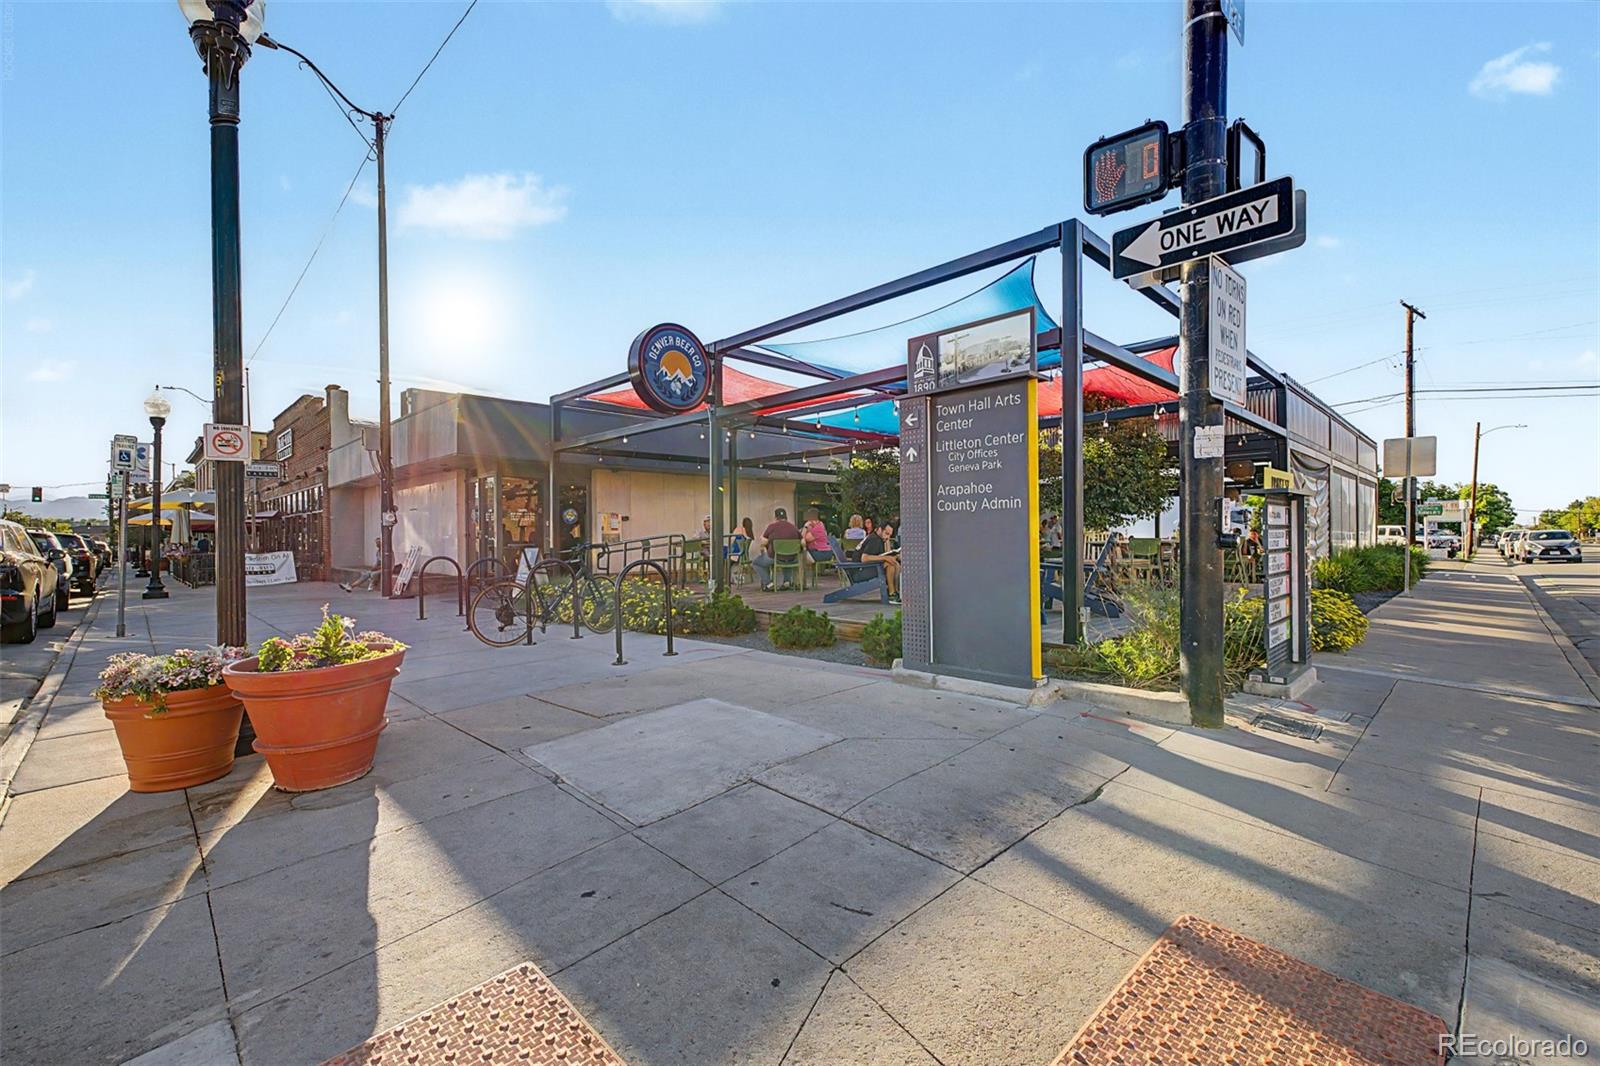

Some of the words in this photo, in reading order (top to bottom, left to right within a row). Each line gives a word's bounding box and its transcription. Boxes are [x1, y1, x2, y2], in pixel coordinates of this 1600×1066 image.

[1161, 220, 1206, 251] ONE
[1217, 200, 1270, 235] WAY
[1213, 265, 1222, 289] NO
[1225, 274, 1244, 305] TURNS
[1217, 297, 1226, 318] ON
[1229, 304, 1240, 328] RED
[1220, 325, 1238, 352] WHEN
[648, 335, 674, 360] DENVER
[676, 336, 695, 357] BEER
[692, 354, 702, 367] CO
[1214, 367, 1242, 396] PRESENT
[936, 403, 965, 417] Town
[968, 396, 990, 412] Hall
[995, 393, 1021, 408] Arts
[936, 418, 973, 432] Center
[936, 438, 981, 452] Littleton
[984, 432, 1024, 446] Center
[948, 451, 965, 462] City
[967, 449, 998, 459] Offices
[948, 463, 980, 473] Geneva
[982, 460, 1002, 469] Park
[937, 482, 993, 496] Arapahoe
[937, 499, 977, 512] County
[981, 496, 1021, 510] Admin
